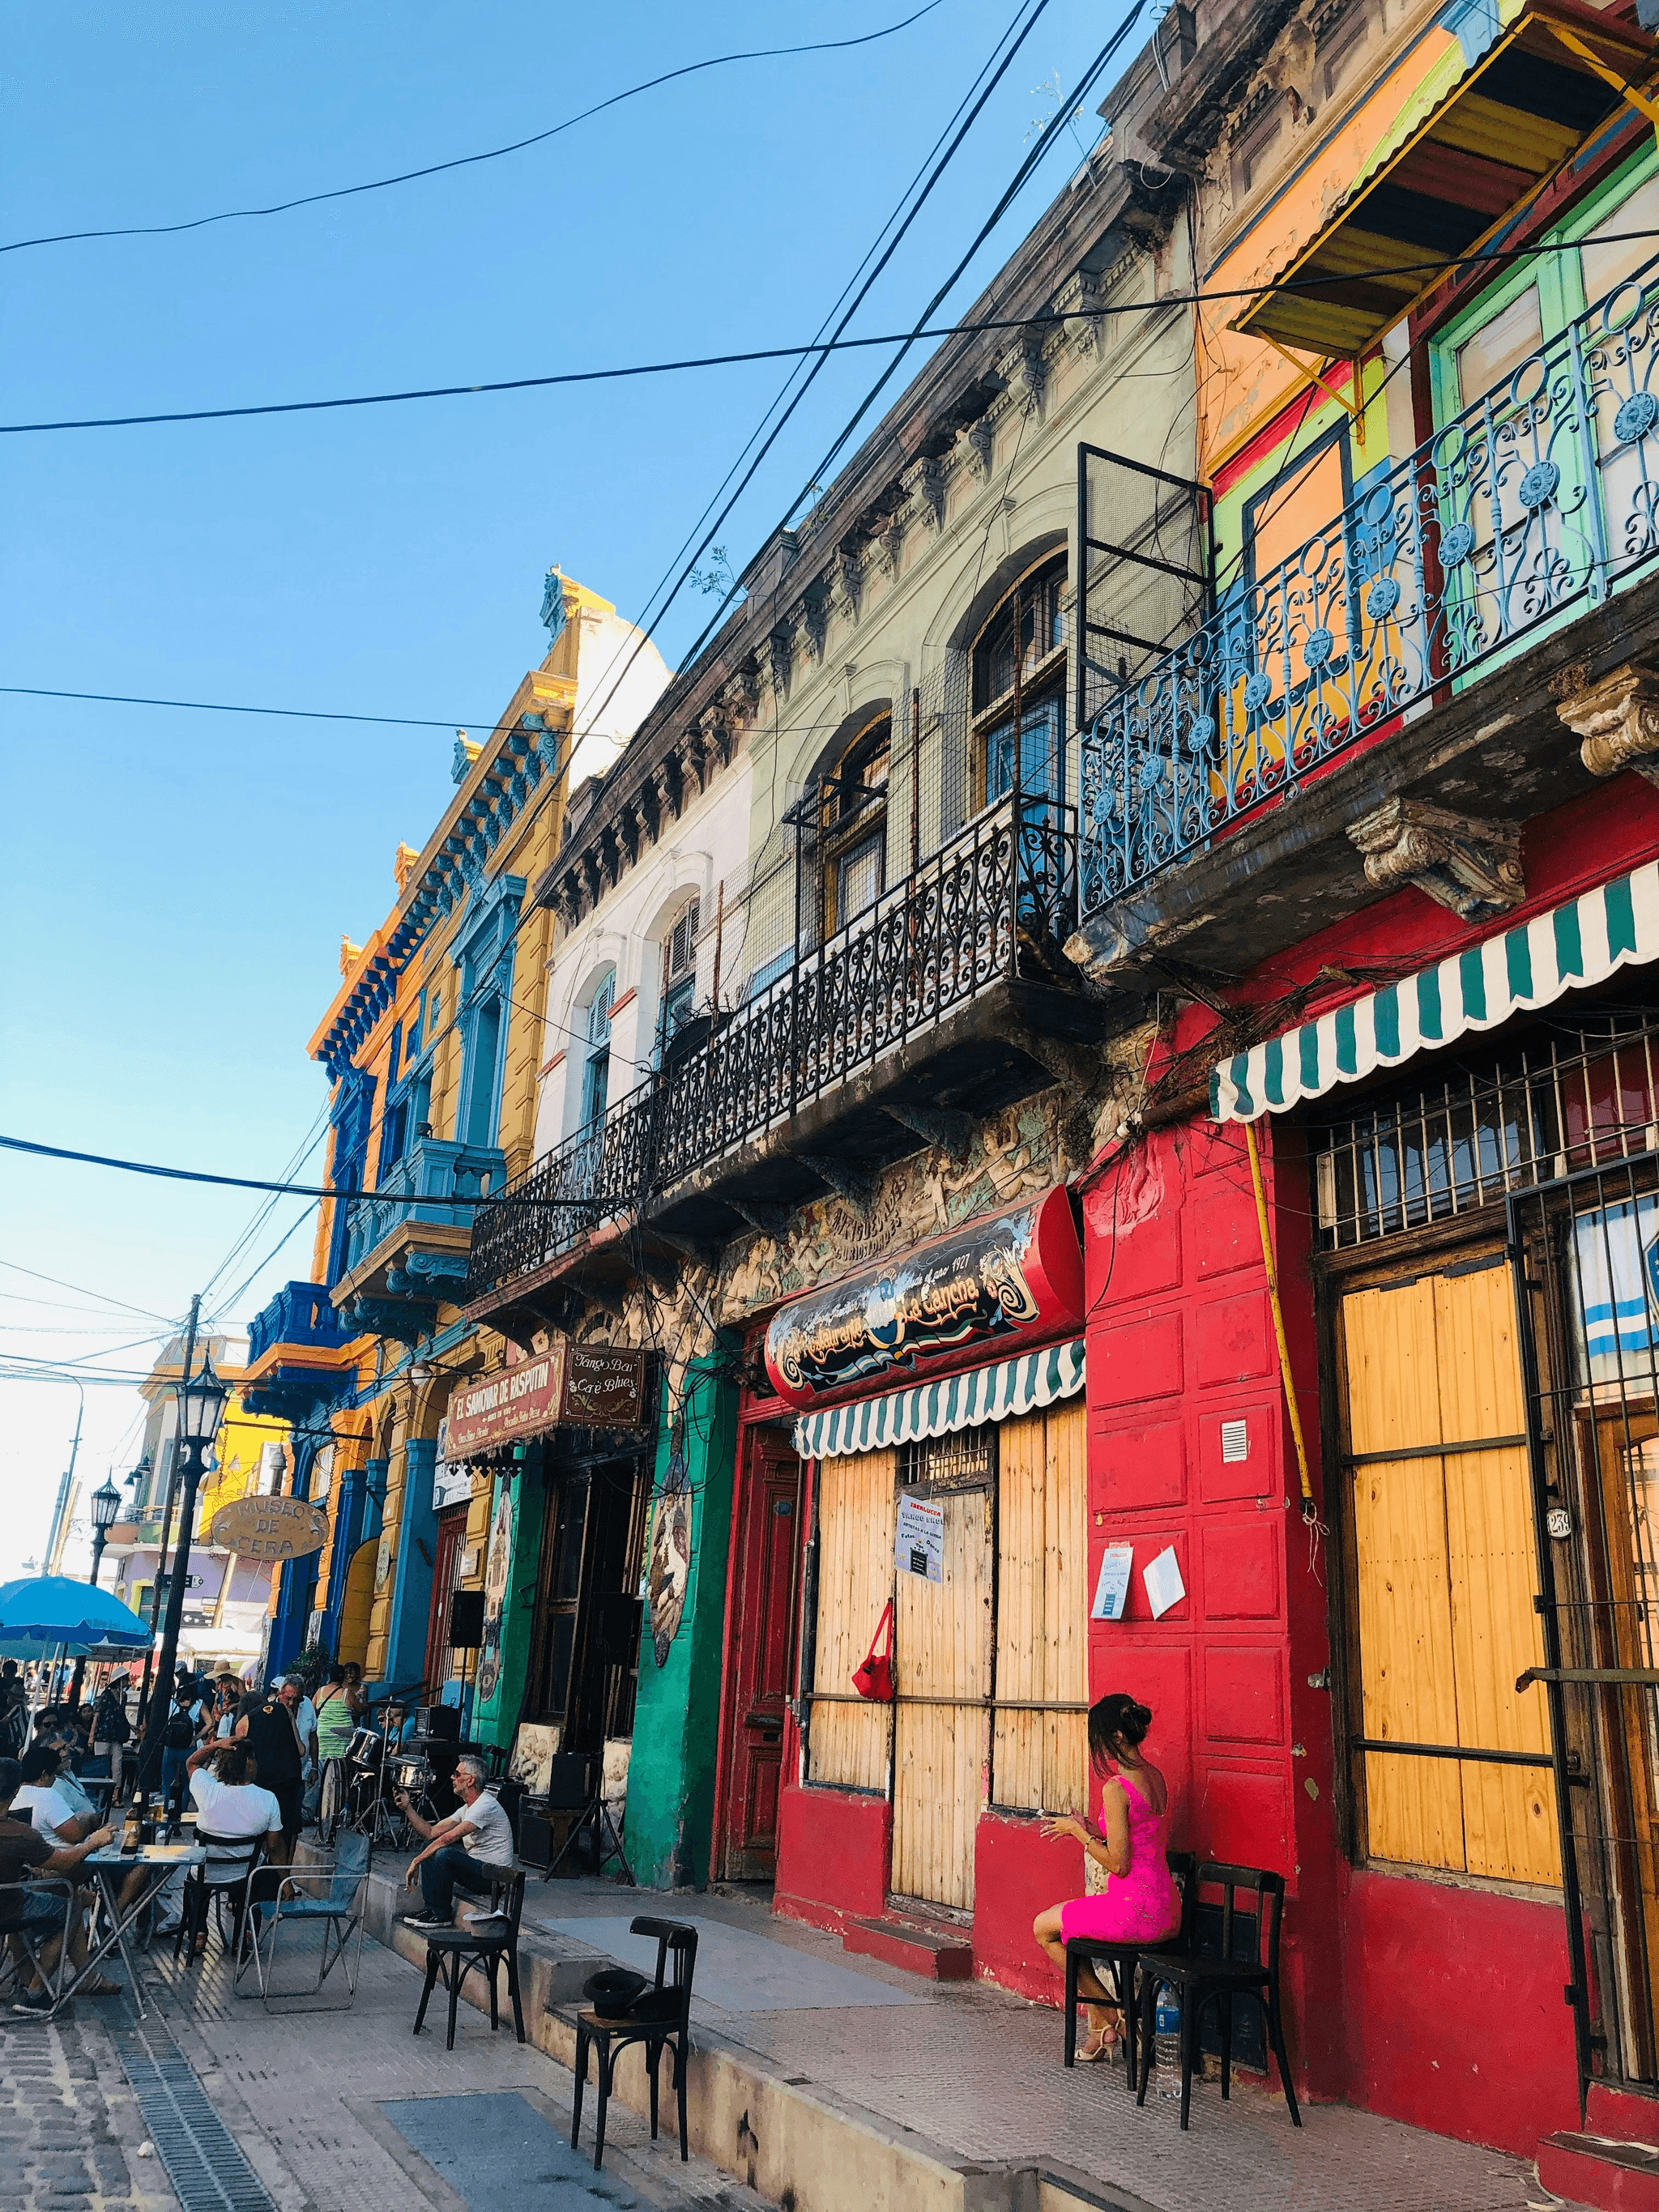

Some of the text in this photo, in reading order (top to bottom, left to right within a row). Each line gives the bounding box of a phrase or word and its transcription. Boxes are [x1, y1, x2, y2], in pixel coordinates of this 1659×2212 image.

[952, 1252, 970, 1272] 1927
[574, 1352, 638, 1372] Tango Bar
[456, 1396, 465, 1421] EL
[465, 1383, 499, 1418] SAMOVAR
[499, 1379, 510, 1405] DE
[510, 1361, 550, 1401] RASPUTIN
[578, 1375, 634, 1394] Caé Blues
[237, 1499, 305, 1519] MUSEO
[255, 1519, 280, 1535] DE
[237, 1536, 294, 1554] CERA
